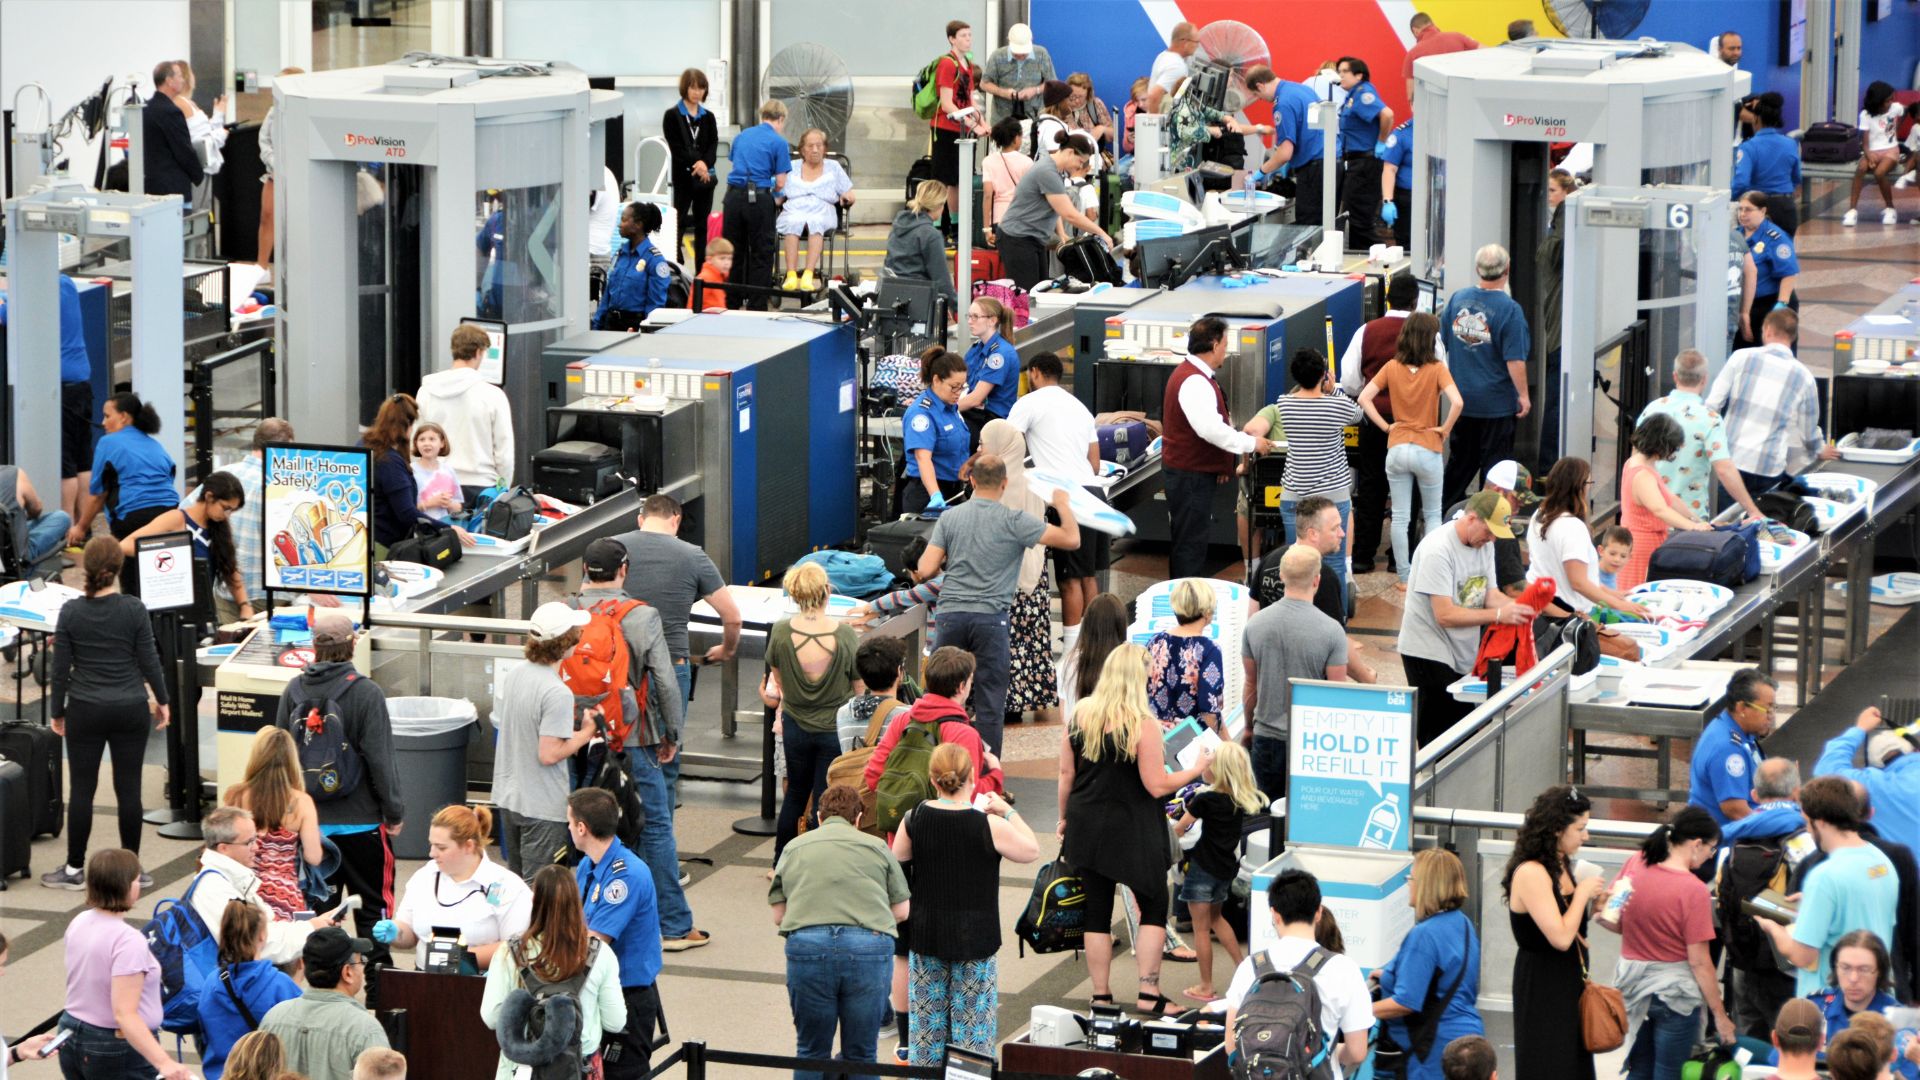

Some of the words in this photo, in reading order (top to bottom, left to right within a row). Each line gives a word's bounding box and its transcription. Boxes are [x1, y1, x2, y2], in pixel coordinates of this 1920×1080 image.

[1516, 115, 1566, 127] ProVision
[1545, 127, 1566, 137] ATD
[357, 135, 406, 147] ProVision
[385, 147, 406, 158] ATD
[1669, 203, 1689, 229] 6
[272, 456, 300, 471] Mail
[305, 458, 313, 472] It
[318, 459, 360, 475] Home
[272, 472, 317, 492] Safely!
[220, 702, 237, 710] Safely
[220, 708, 240, 716] Airport
[1303, 710, 1376, 731] EMPTY
[1382, 716, 1399, 734] IT
[1302, 731, 1370, 754] HOLD
[1377, 737, 1399, 756] IT
[1302, 754, 1374, 776] REFILL
[1380, 760, 1399, 777] IT
[1301, 784, 1322, 794] POUR
[1323, 786, 1338, 796] OUT
[1340, 788, 1365, 798] WATER
[1301, 793, 1317, 802] AND
[1317, 794, 1360, 806] BEVERAGES
[1301, 802, 1320, 811] HERE
